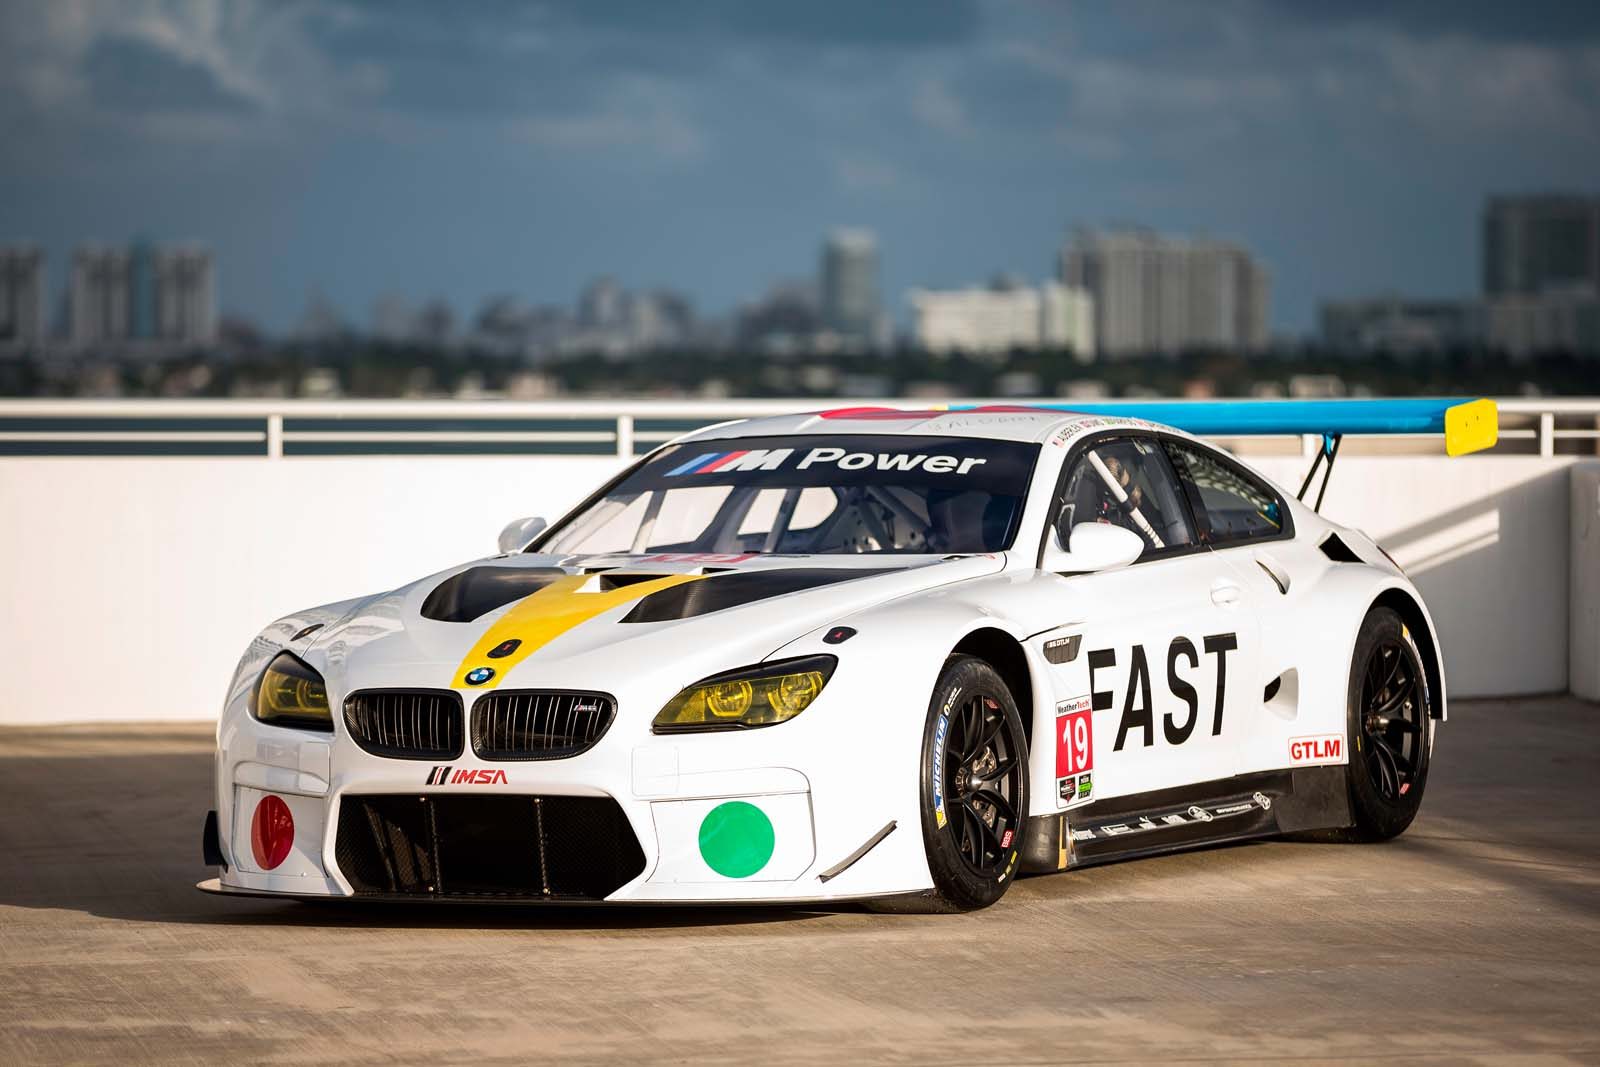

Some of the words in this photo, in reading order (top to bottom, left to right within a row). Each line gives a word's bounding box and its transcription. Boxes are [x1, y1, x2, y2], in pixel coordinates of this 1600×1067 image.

[710, 448, 795, 473] M
[796, 447, 987, 475] Power
[1088, 632, 1238, 752] FAST
[1057, 701, 1089, 714] WeatherTech
[934, 718, 947, 796] MICHELIN
[1063, 717, 1088, 772] 19
[1291, 739, 1341, 760] GTLM
[451, 769, 508, 784] IMSA
